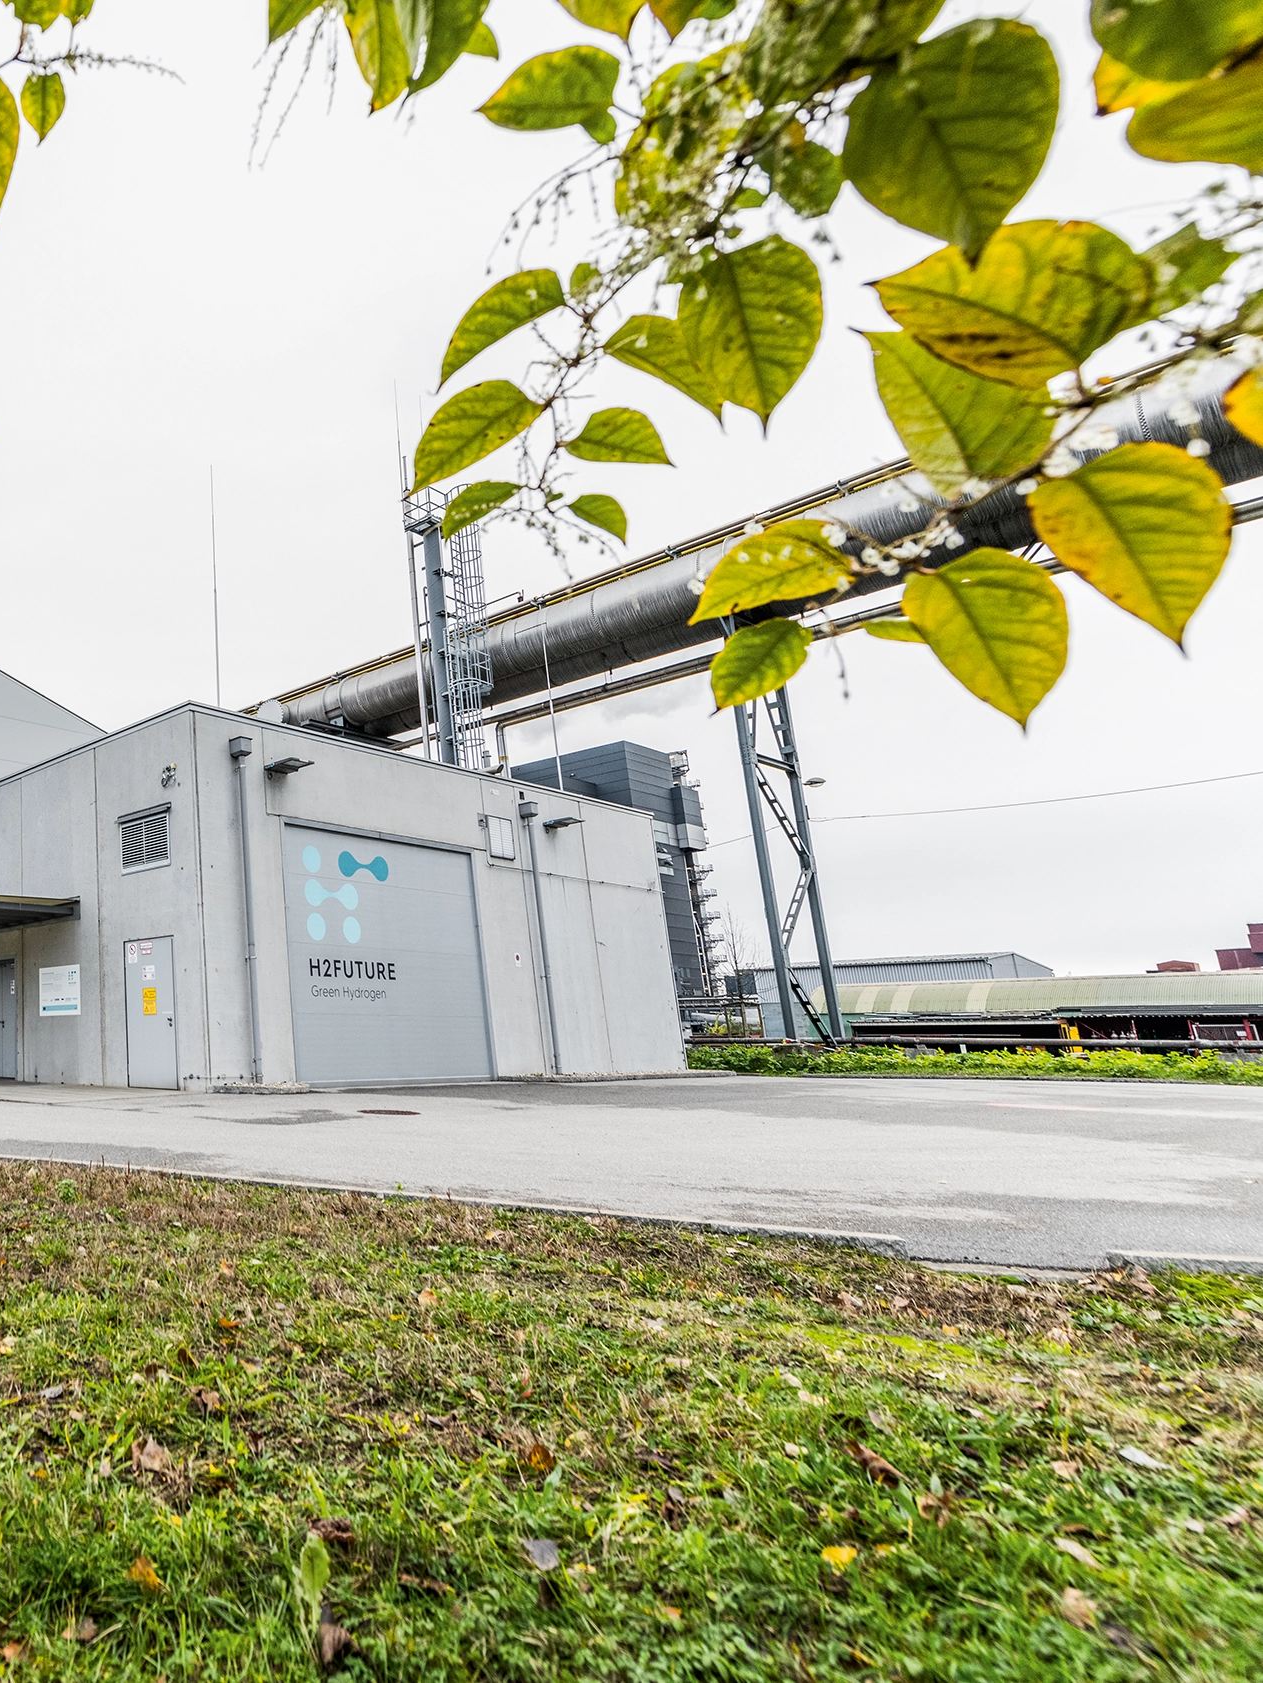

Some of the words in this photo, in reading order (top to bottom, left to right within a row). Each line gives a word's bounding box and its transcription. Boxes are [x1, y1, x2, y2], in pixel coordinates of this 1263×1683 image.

[309, 958, 396, 980] H2FUTURE
[311, 985, 340, 997] Green
[343, 986, 387, 1001] Hydrogen
